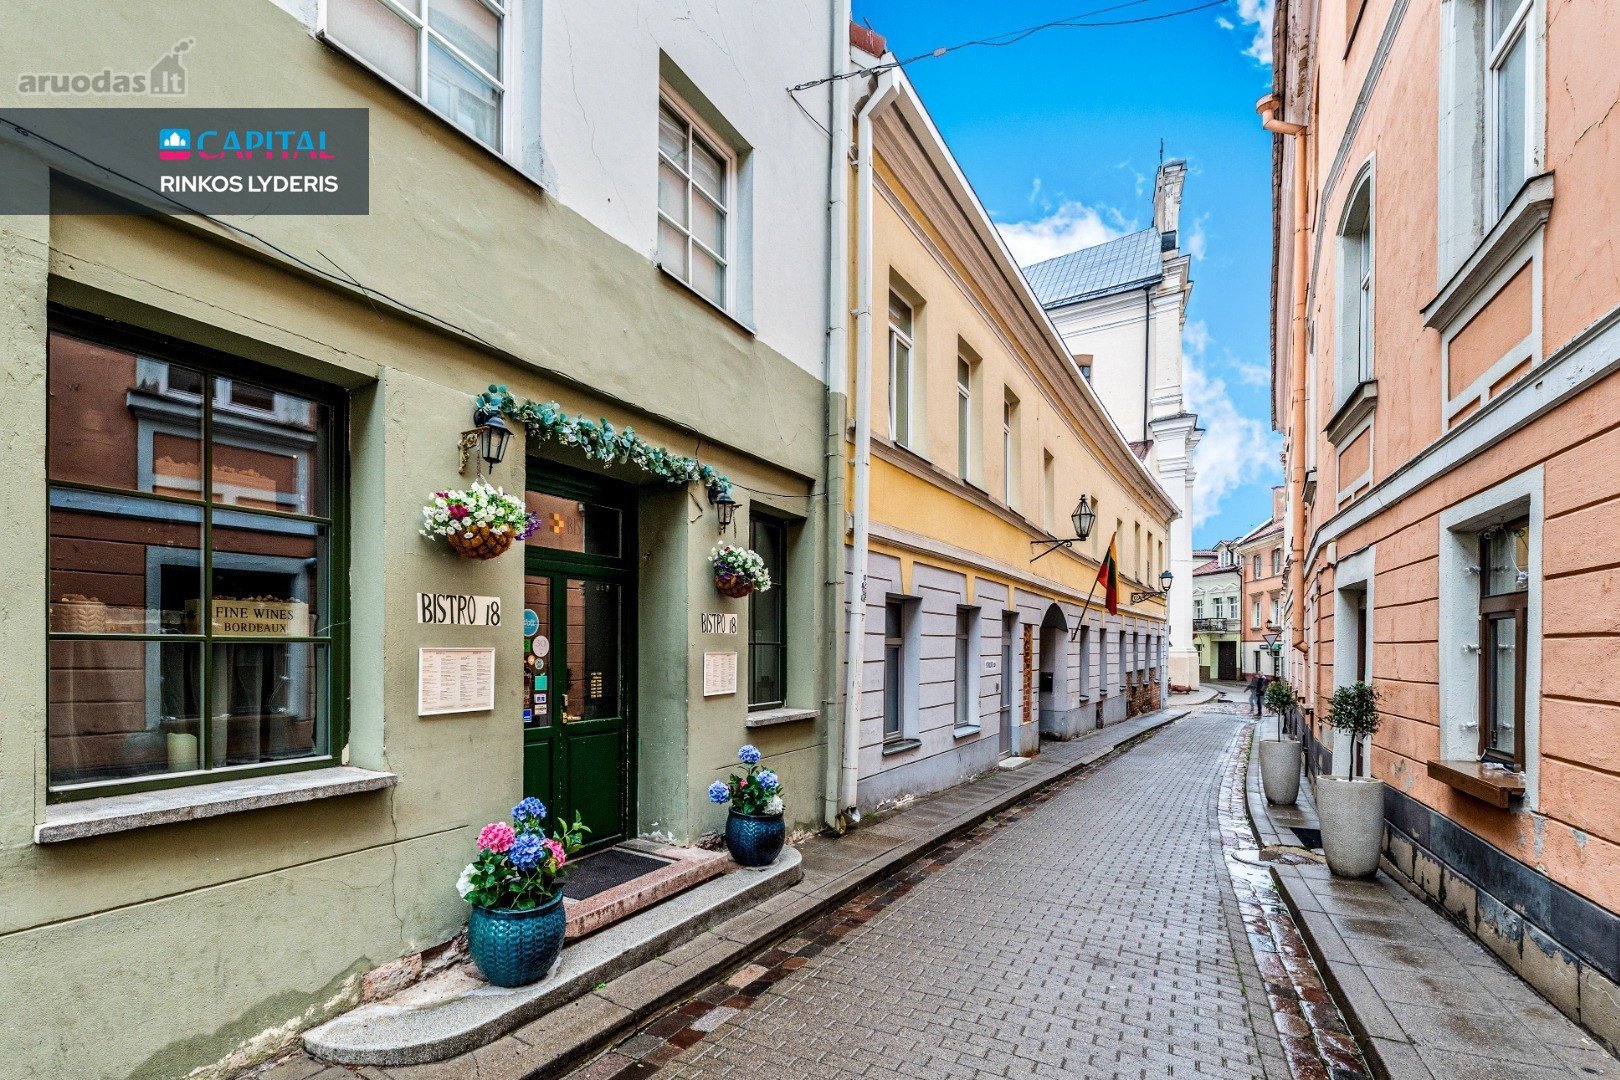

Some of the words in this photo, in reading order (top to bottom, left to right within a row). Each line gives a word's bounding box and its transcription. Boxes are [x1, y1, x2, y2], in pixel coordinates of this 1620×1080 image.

[215, 606, 248, 618] FINE
[253, 608, 294, 620] WINES
[422, 593, 476, 625] BISTRO
[486, 601, 500, 626] 18
[224, 622, 287, 633] BORDEAUX
[701, 613, 726, 633] BISTRO
[729, 617, 737, 634] 18
